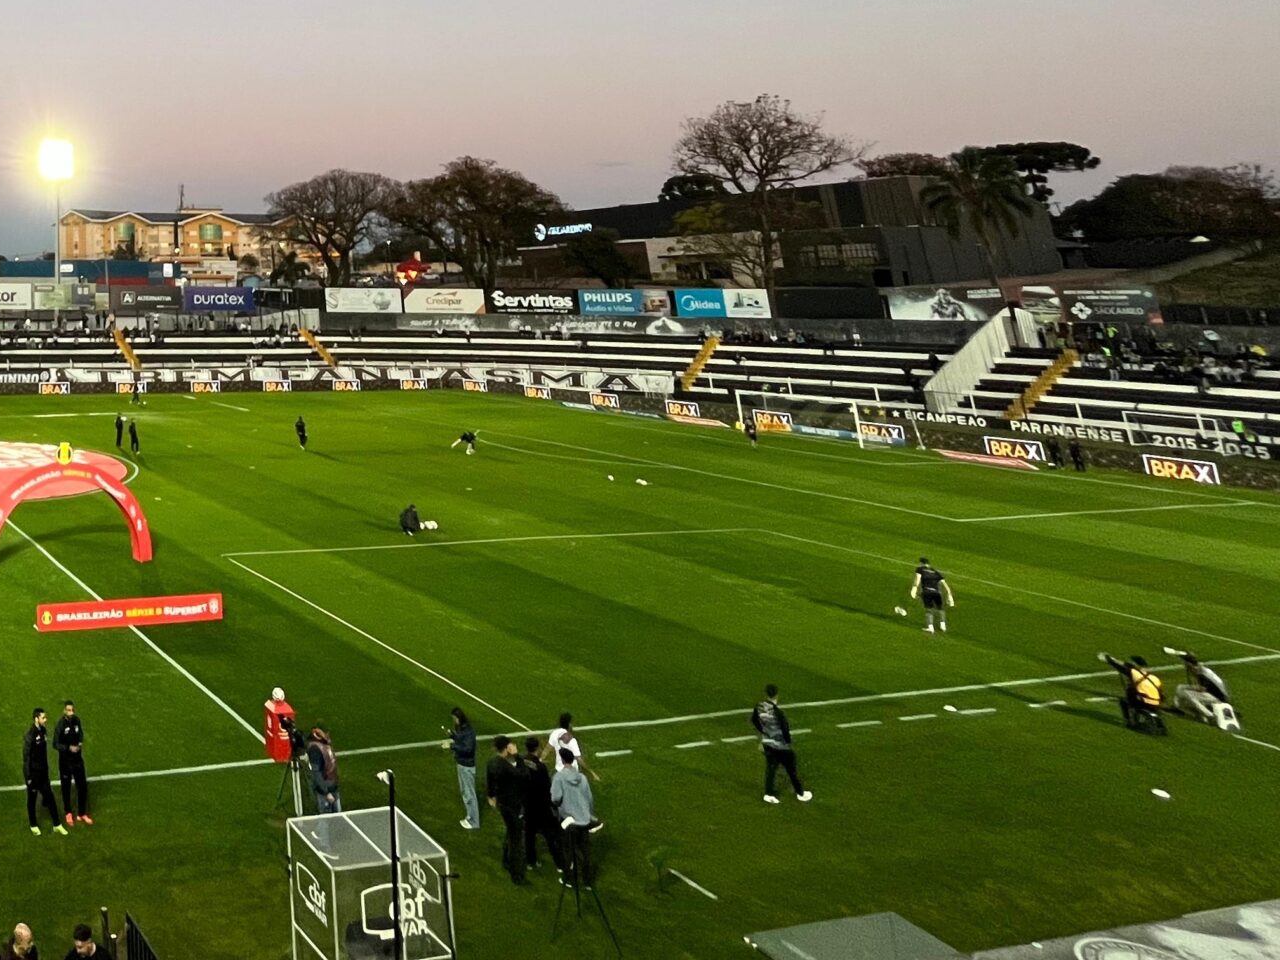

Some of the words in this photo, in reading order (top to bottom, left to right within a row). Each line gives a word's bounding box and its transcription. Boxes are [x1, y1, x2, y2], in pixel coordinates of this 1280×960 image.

[425, 296, 463, 307] Credipar
[491, 290, 573, 308] Servtintas
[584, 292, 633, 303] PHILIPS
[690, 298, 721, 310] Midea
[41, 384, 68, 394] BRAX
[194, 383, 218, 393] BRAX
[266, 382, 290, 392] BRAX
[335, 381, 358, 391] BRAX
[403, 380, 425, 390] BRAX
[466, 381, 485, 392] BRAX
[526, 387, 549, 399] BRAX
[592, 394, 618, 408] BRAX
[668, 403, 698, 417] BRAX
[756, 413, 790, 426] BRAX
[861, 424, 901, 440] BRAX
[1010, 420, 1125, 443] PARANAENSE
[1152, 434, 1198, 449] 2015
[1212, 440, 1271, 460] 2025
[990, 440, 1042, 461] BRAX
[1150, 459, 1214, 484] BRAX
[56, 609, 124, 622] BRASILEIRÃO
[126, 609, 156, 618] SÉRIE
[164, 602, 208, 616] SUPERBET
